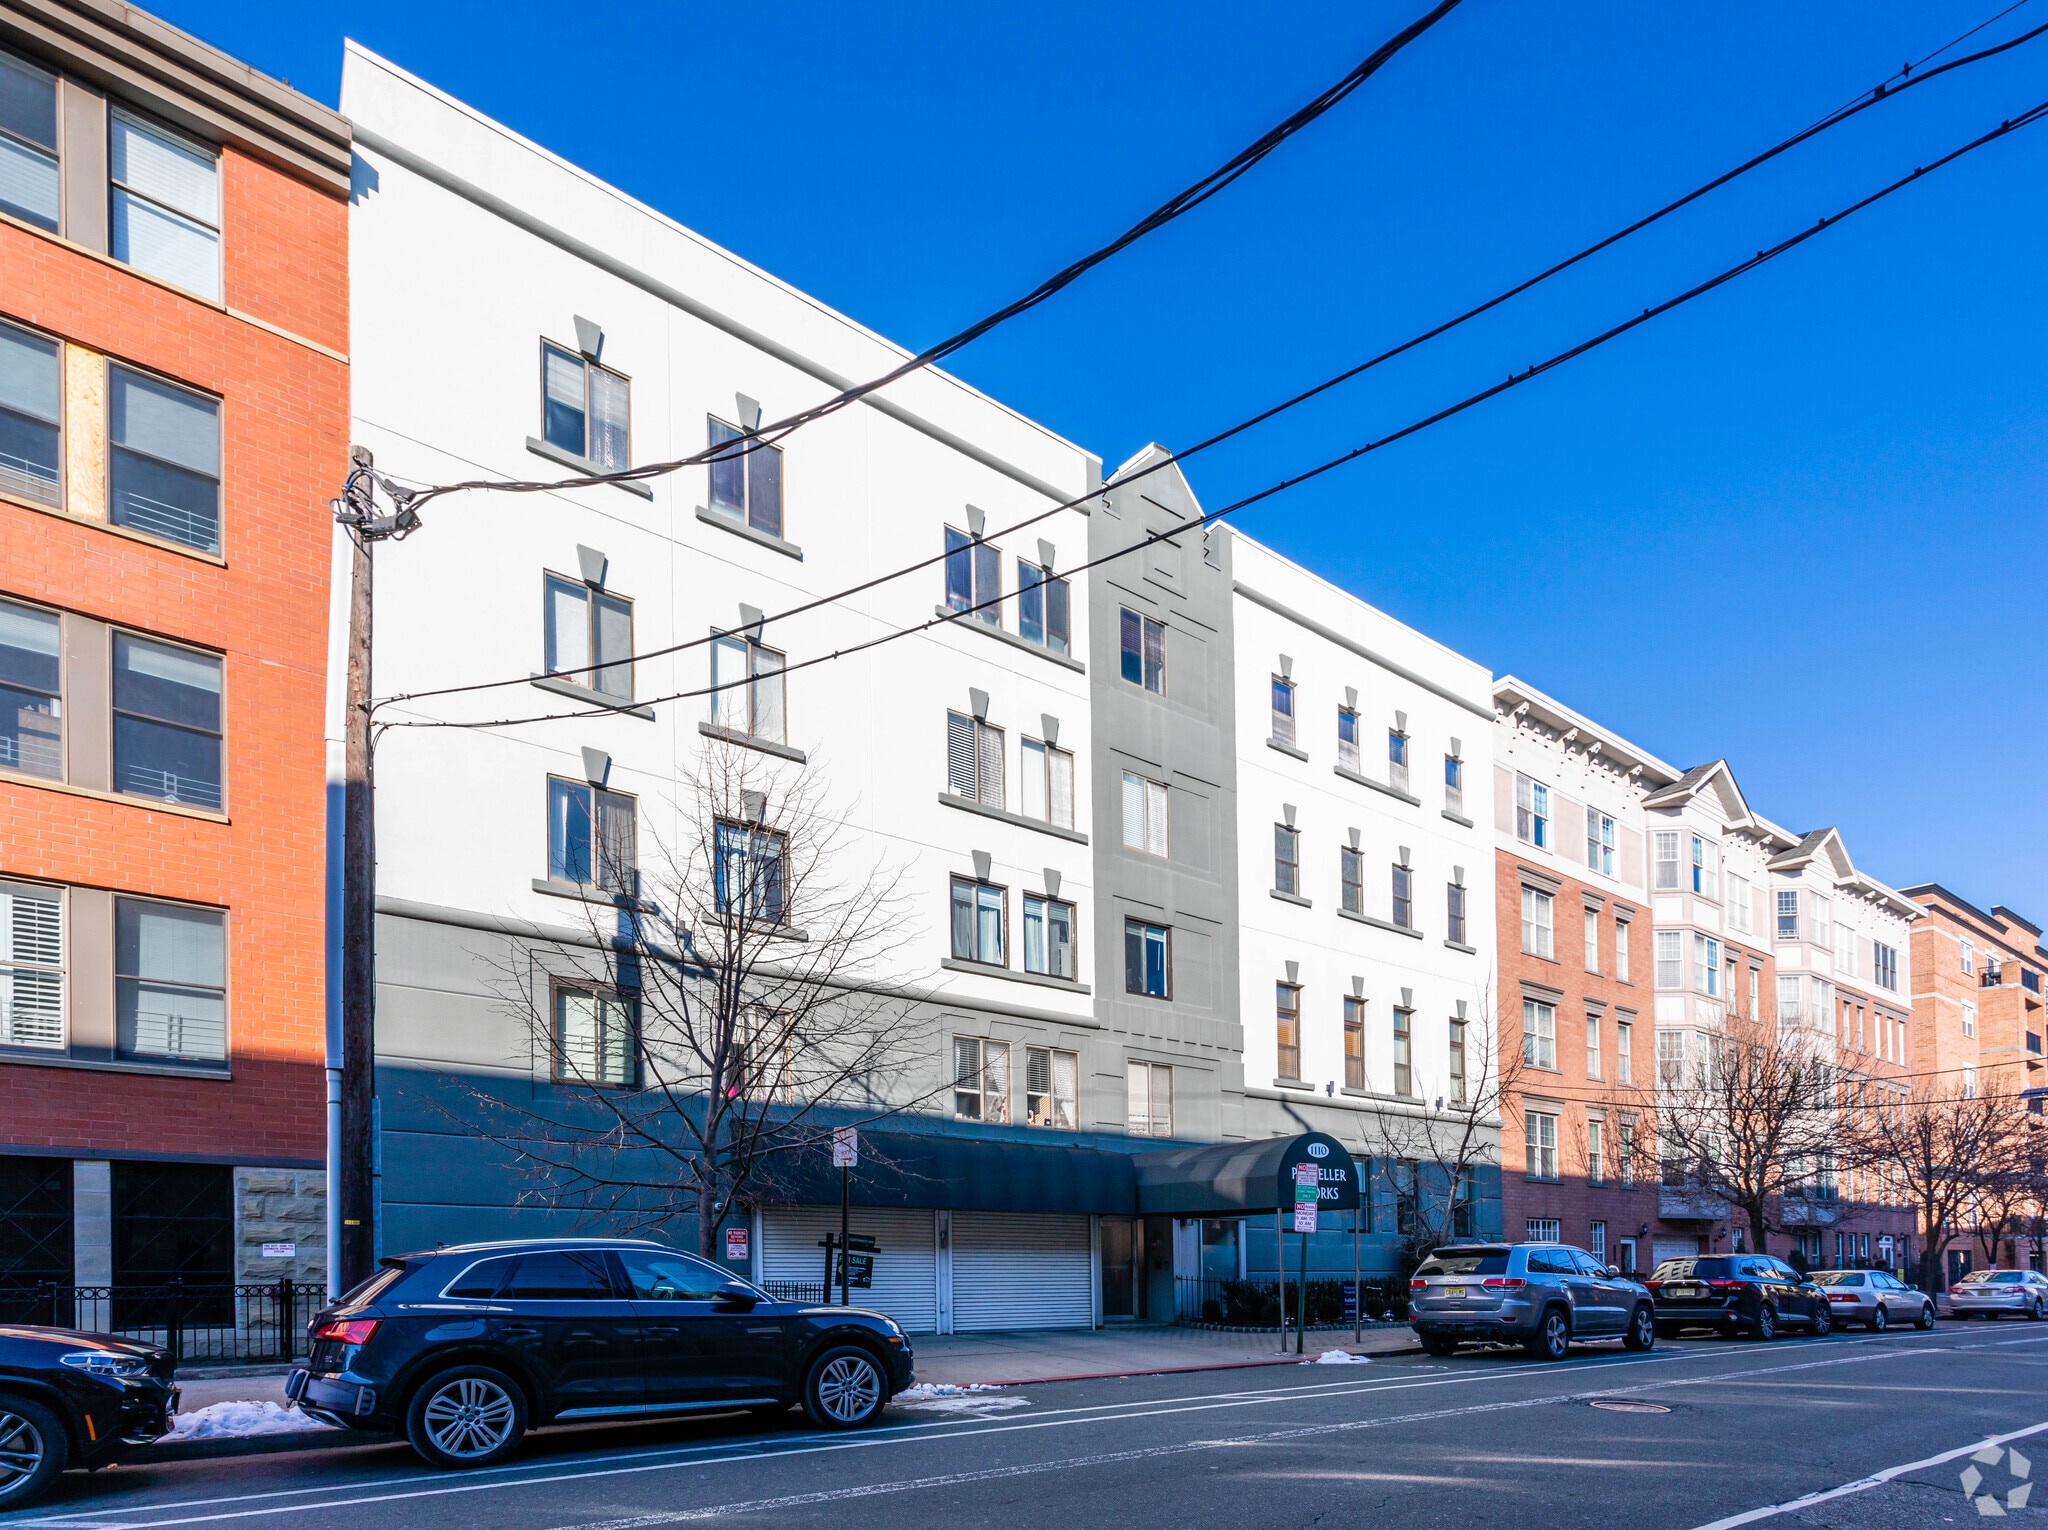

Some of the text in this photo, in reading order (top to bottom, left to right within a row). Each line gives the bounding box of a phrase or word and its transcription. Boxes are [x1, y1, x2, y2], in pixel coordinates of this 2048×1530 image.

[1310, 1145, 1327, 1156] 1110
[1291, 1166, 1347, 1181] PELLER
[839, 1254, 867, 1265] FR SALE
